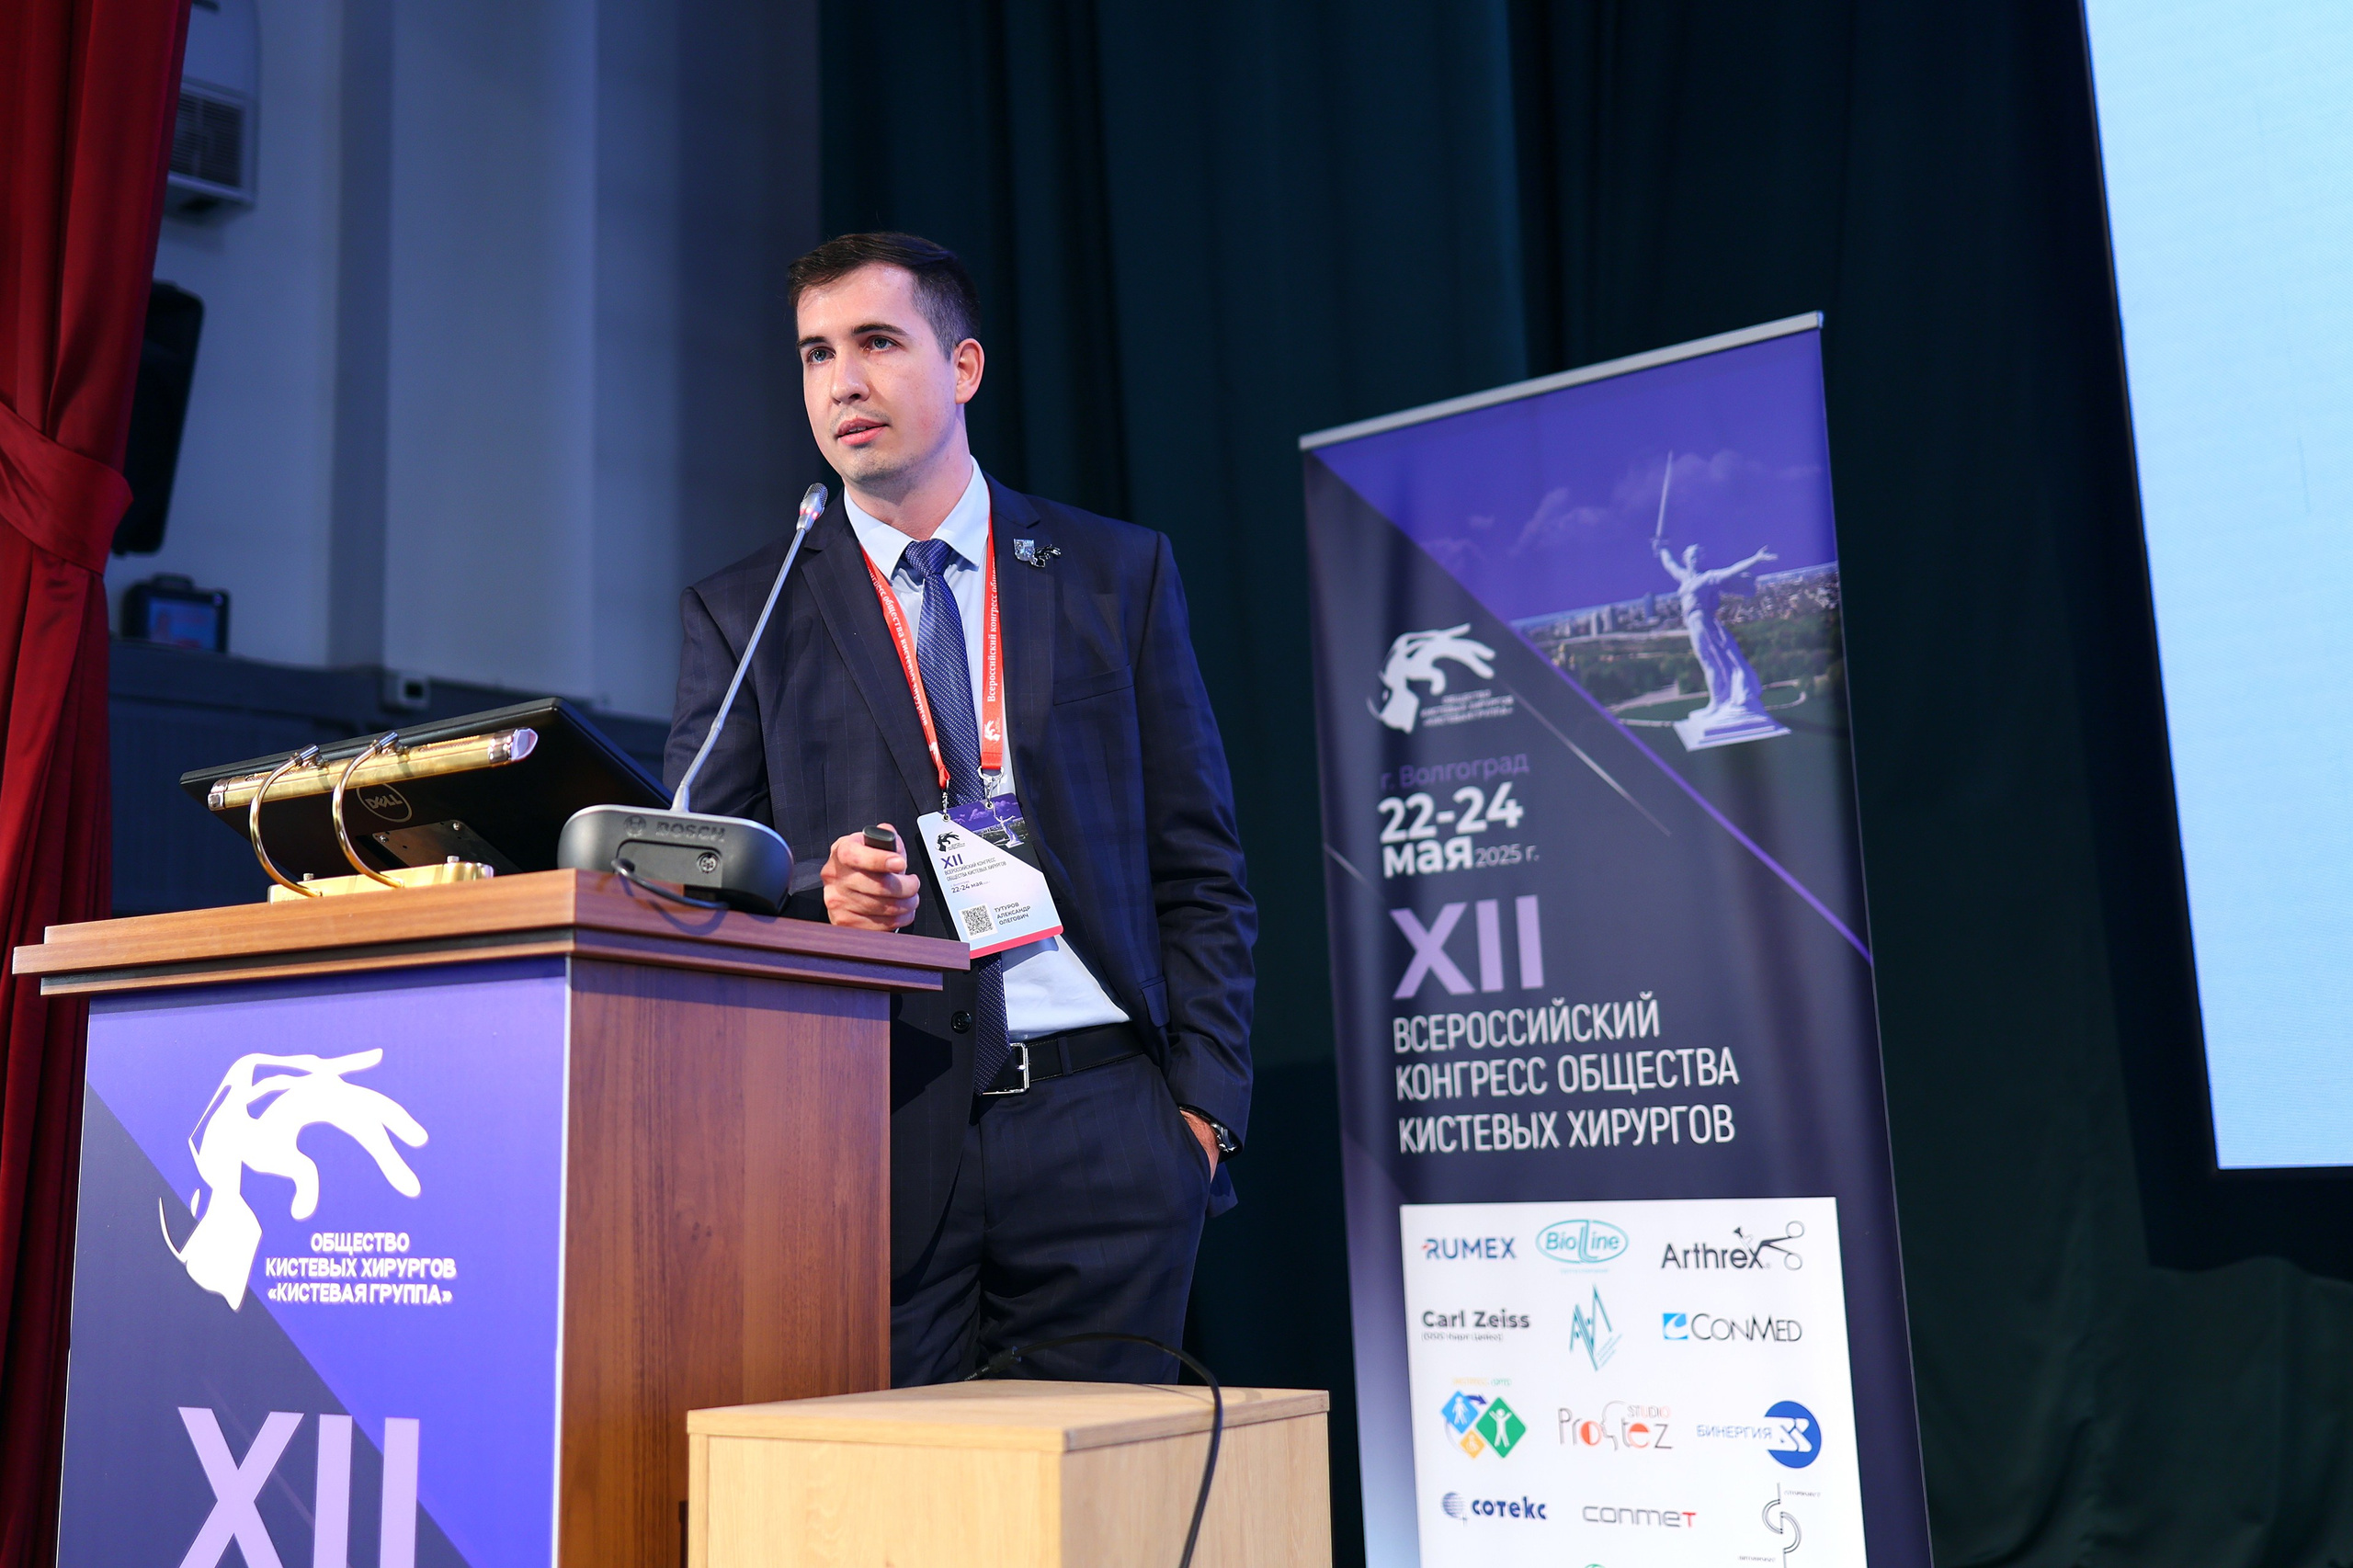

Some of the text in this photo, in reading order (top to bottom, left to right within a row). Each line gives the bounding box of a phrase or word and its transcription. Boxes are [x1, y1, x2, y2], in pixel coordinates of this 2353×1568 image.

[883, 596, 904, 638] общества
[990, 595, 1000, 632] конгресс
[986, 634, 997, 702] Всероссийский
[1399, 754, 1529, 788] Волгоград
[365, 794, 404, 809] DELL
[1377, 781, 1524, 844] 22-24
[655, 821, 725, 843] BOSCH
[940, 854, 963, 869] XII
[1382, 835, 1540, 879] мая 2025 г.
[994, 902, 1019, 913] ТУТУРОВ
[996, 905, 1031, 919] АЛЕКСАНДР
[998, 914, 1029, 926] ОЛЕГОВИЧ
[1390, 894, 1544, 1000] XII
[1392, 990, 1660, 1054] ВСЕРОССИЙСКИЙ
[1396, 1047, 1739, 1101] КОНГРЕСС ОБЩЕСТВА
[1399, 1104, 1735, 1153] КИСТЕВЫХ ХИРУРГОВ
[311, 1232, 411, 1256] ОБЩЕСТВО
[1425, 1237, 1517, 1259] RUMEX
[266, 1257, 458, 1279] КИСТЕВЫХ ХИРУРГОВ
[267, 1282, 453, 1304] «КИСТЕВАЯ ГРУППА»
[1422, 1309, 1529, 1328] Carl Zeiss
[1627, 1404, 1671, 1419] STUDIO
[1696, 1425, 1772, 1439] БИНЕРГИЯ
[178, 1407, 420, 1568] XII
